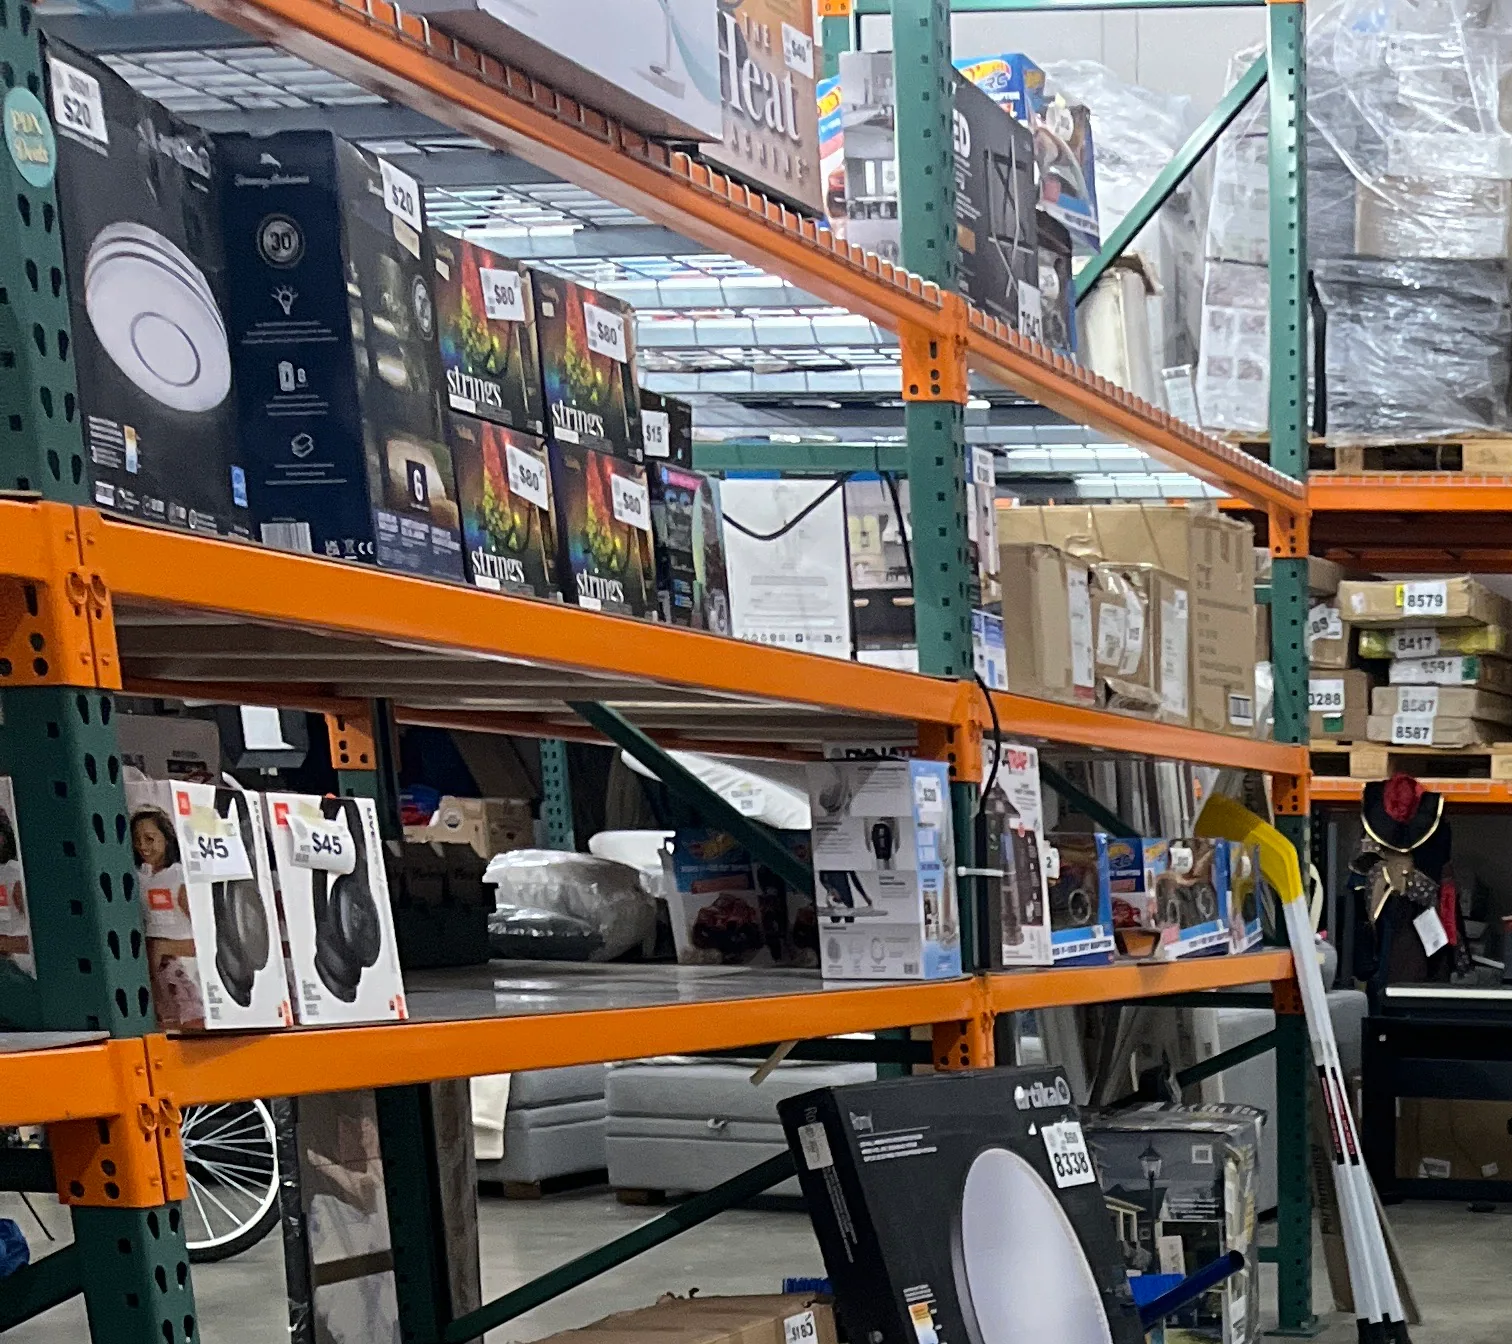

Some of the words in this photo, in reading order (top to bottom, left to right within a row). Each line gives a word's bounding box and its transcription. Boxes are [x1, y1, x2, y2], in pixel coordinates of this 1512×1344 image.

[391, 184, 414, 216] $20
[269, 231, 293, 251] 30
[493, 284, 515, 306] $80
[595, 321, 618, 346] $80
[446, 365, 503, 408] strings
[551, 400, 605, 438] strings
[645, 425, 663, 443] $15
[518, 464, 540, 493] $80
[471, 546, 525, 584] strings
[575, 568, 625, 604] strings
[1407, 594, 1443, 608] 8579
[1396, 726, 1430, 740] 8587
[197, 835, 229, 859] $45
[311, 832, 342, 856] $45
[1054, 1151, 1089, 1178] 8338
